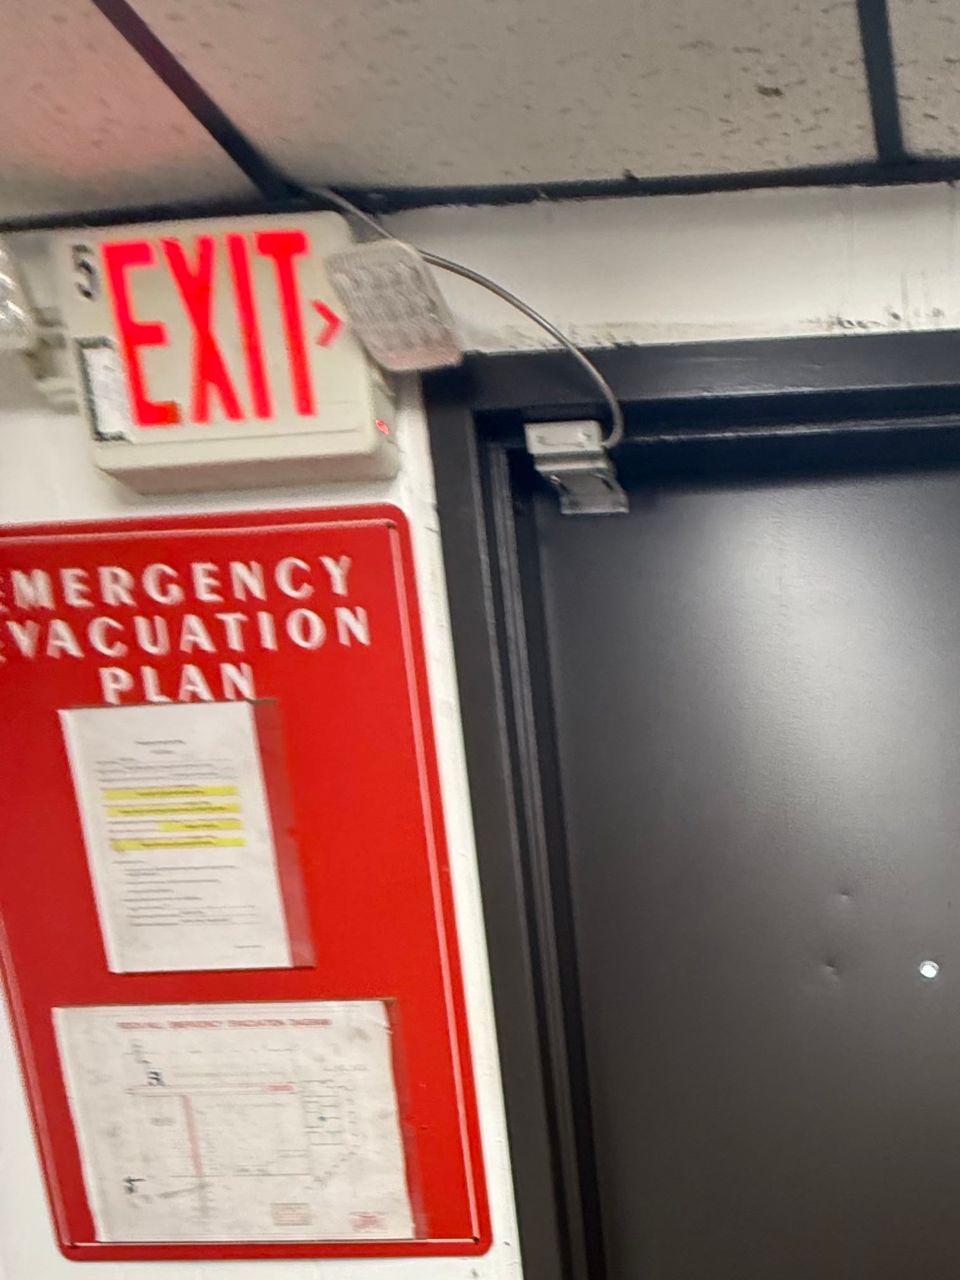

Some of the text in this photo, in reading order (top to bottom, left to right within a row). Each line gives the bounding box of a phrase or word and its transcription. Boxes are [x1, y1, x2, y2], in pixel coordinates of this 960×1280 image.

[102, 230, 316, 427] EXIT
[0, 606, 370, 662] VACUATION
[98, 662, 257, 705] PLAN
